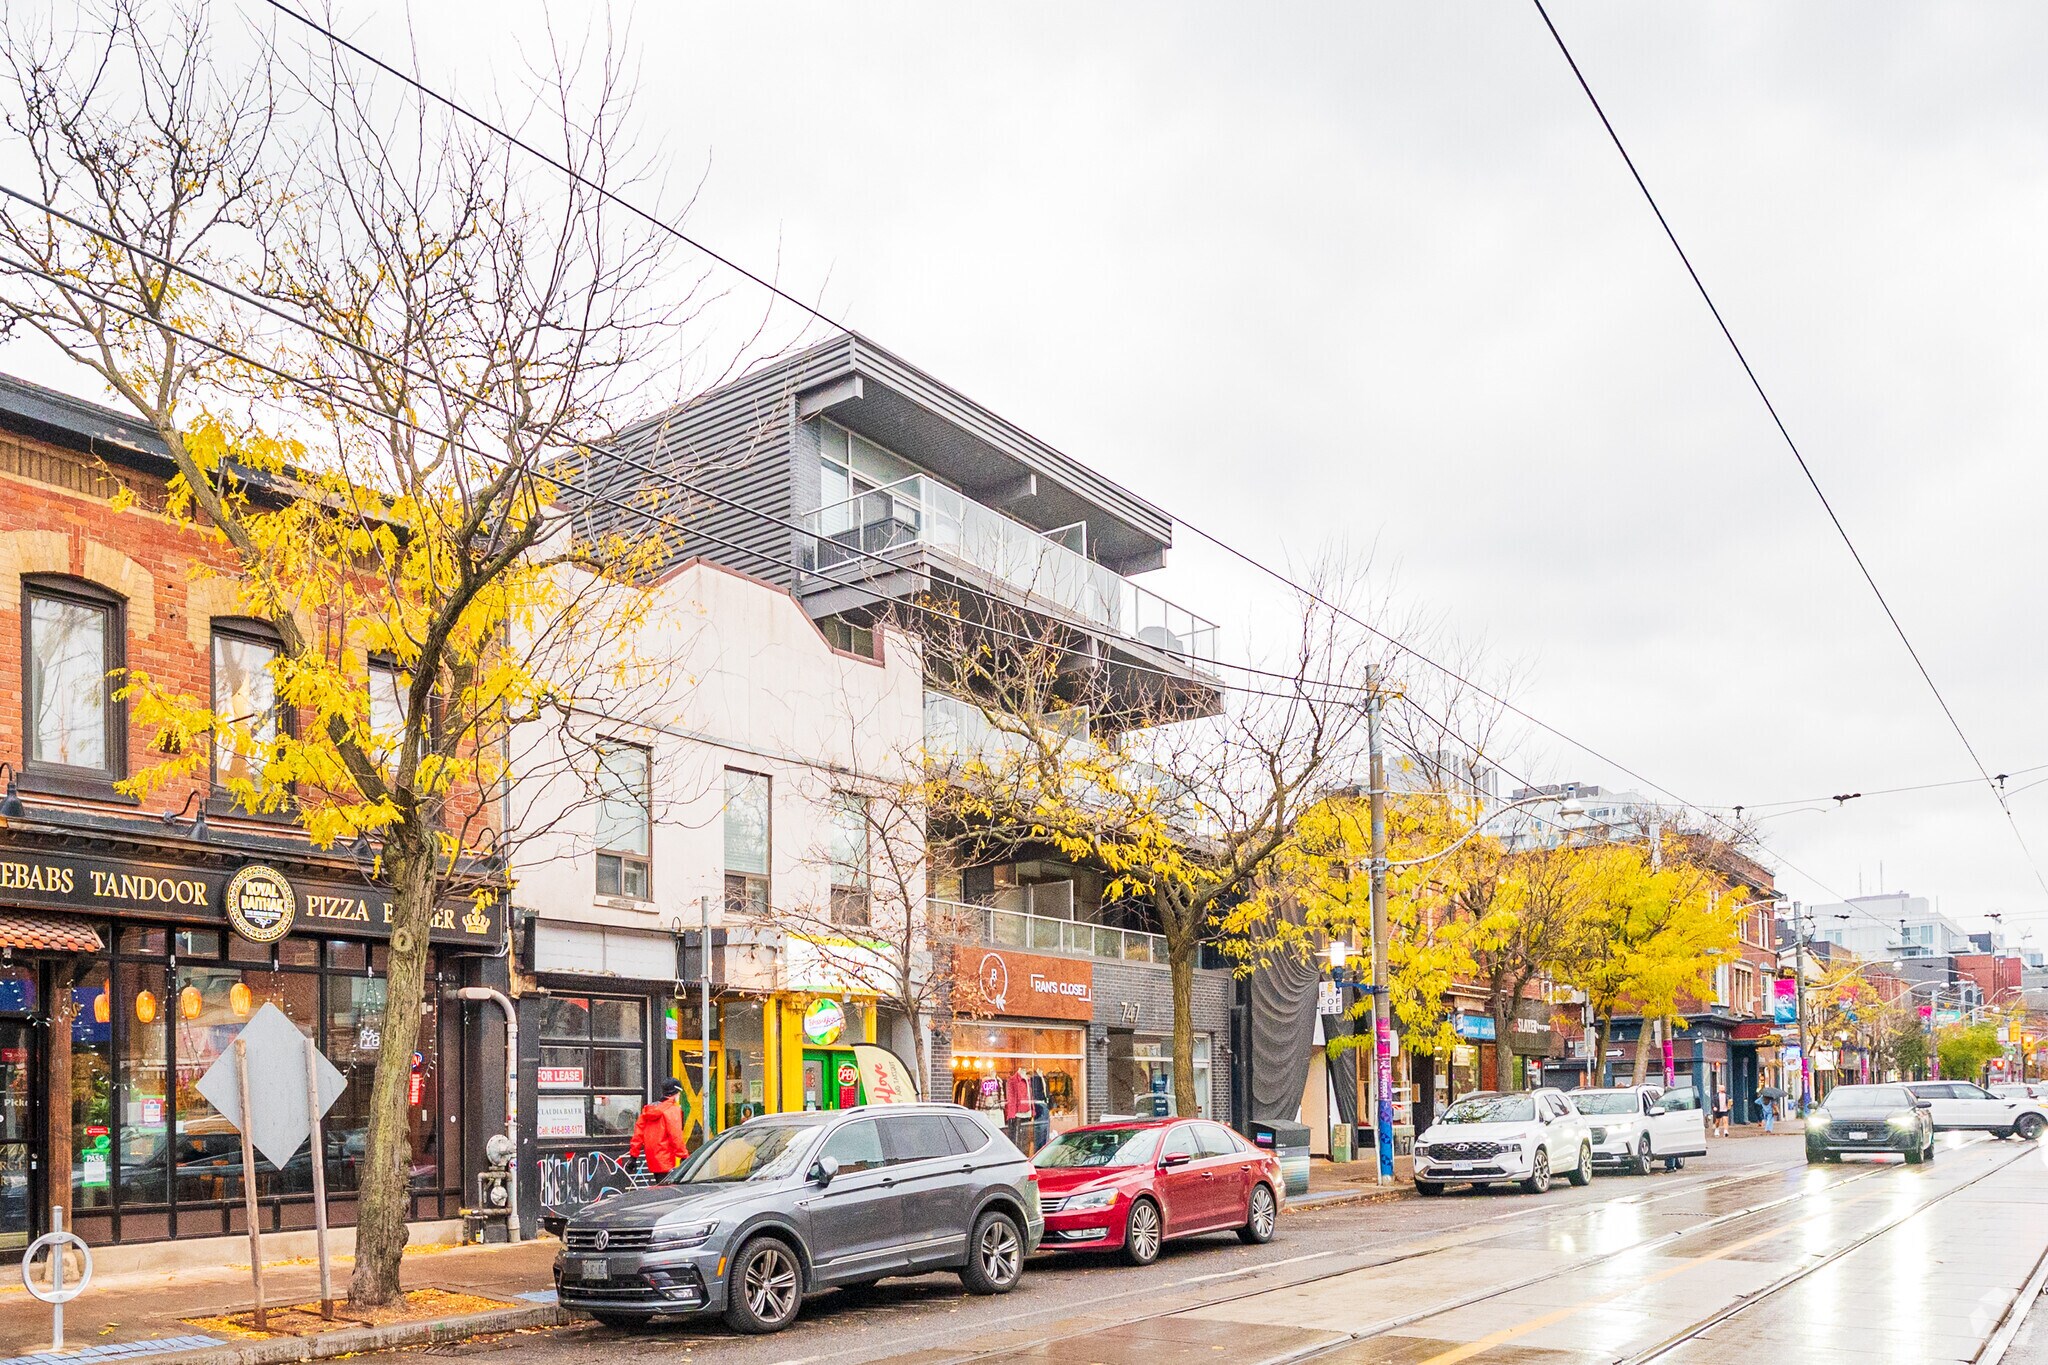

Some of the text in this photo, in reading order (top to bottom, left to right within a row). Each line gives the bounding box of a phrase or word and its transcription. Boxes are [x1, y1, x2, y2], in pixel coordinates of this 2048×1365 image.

[0, 862, 208, 906] EBABS TANDOOR
[245, 881, 279, 898] ROYAL
[241, 895, 285, 913] BAITHAK
[306, 895, 455, 930] PIZZA BER
[1035, 980, 1087, 996] RAN'S CLOSET
[1120, 1002, 1140, 1022] 747
[554, 1071, 580, 1081] LEASE
[839, 1067, 855, 1081] OPEN
[888, 1061, 899, 1084] TAKEOUT
[983, 1081, 998, 1096] open
[86, 1154, 104, 1162] PASS
